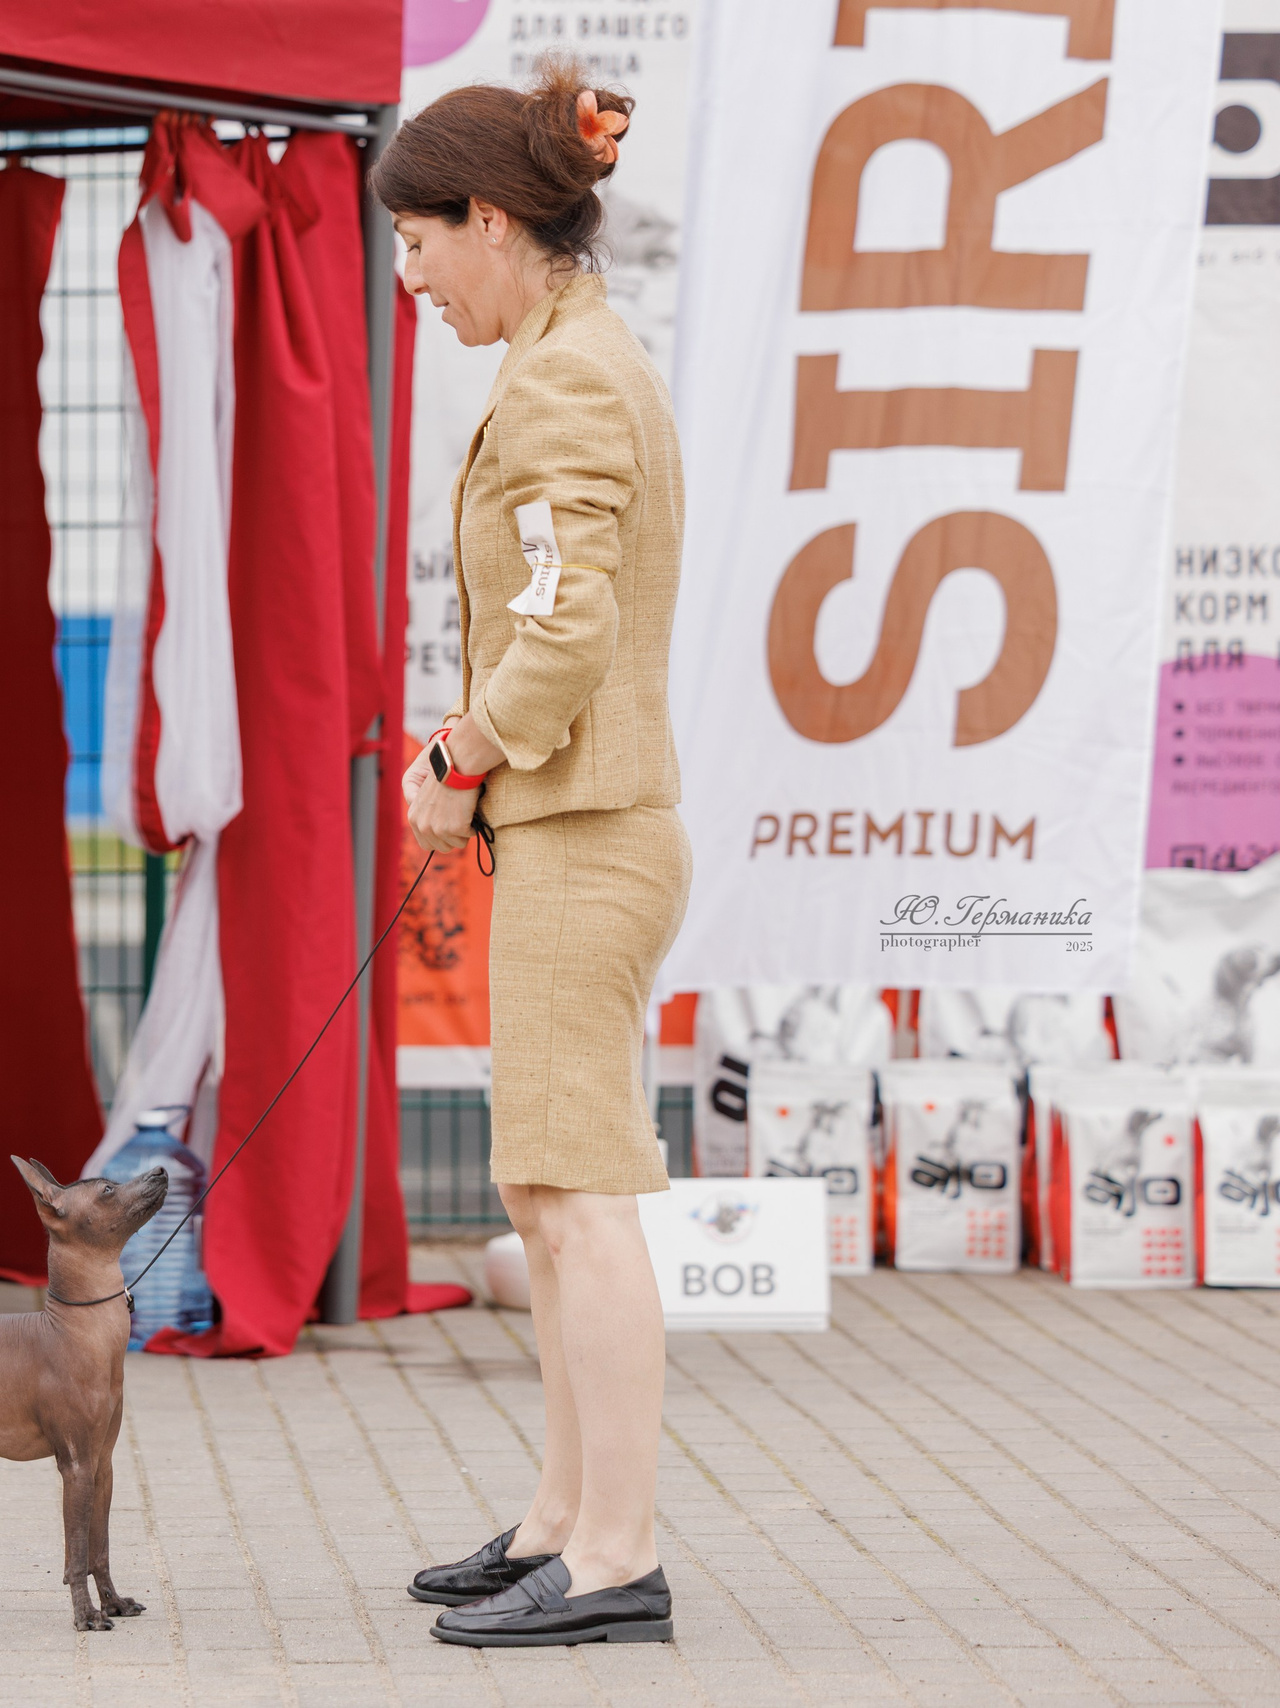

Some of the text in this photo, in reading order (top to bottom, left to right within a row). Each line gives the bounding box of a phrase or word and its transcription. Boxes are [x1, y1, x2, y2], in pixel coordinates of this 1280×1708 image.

[510, 14, 689, 41] ДЛЯ ВАШЕГО
[1175, 591, 1268, 624] КОРМ
[1173, 638, 1245, 676] ДЛЯ
[749, 811, 1037, 861] PREMIUM
[682, 1263, 776, 1297] BOB
